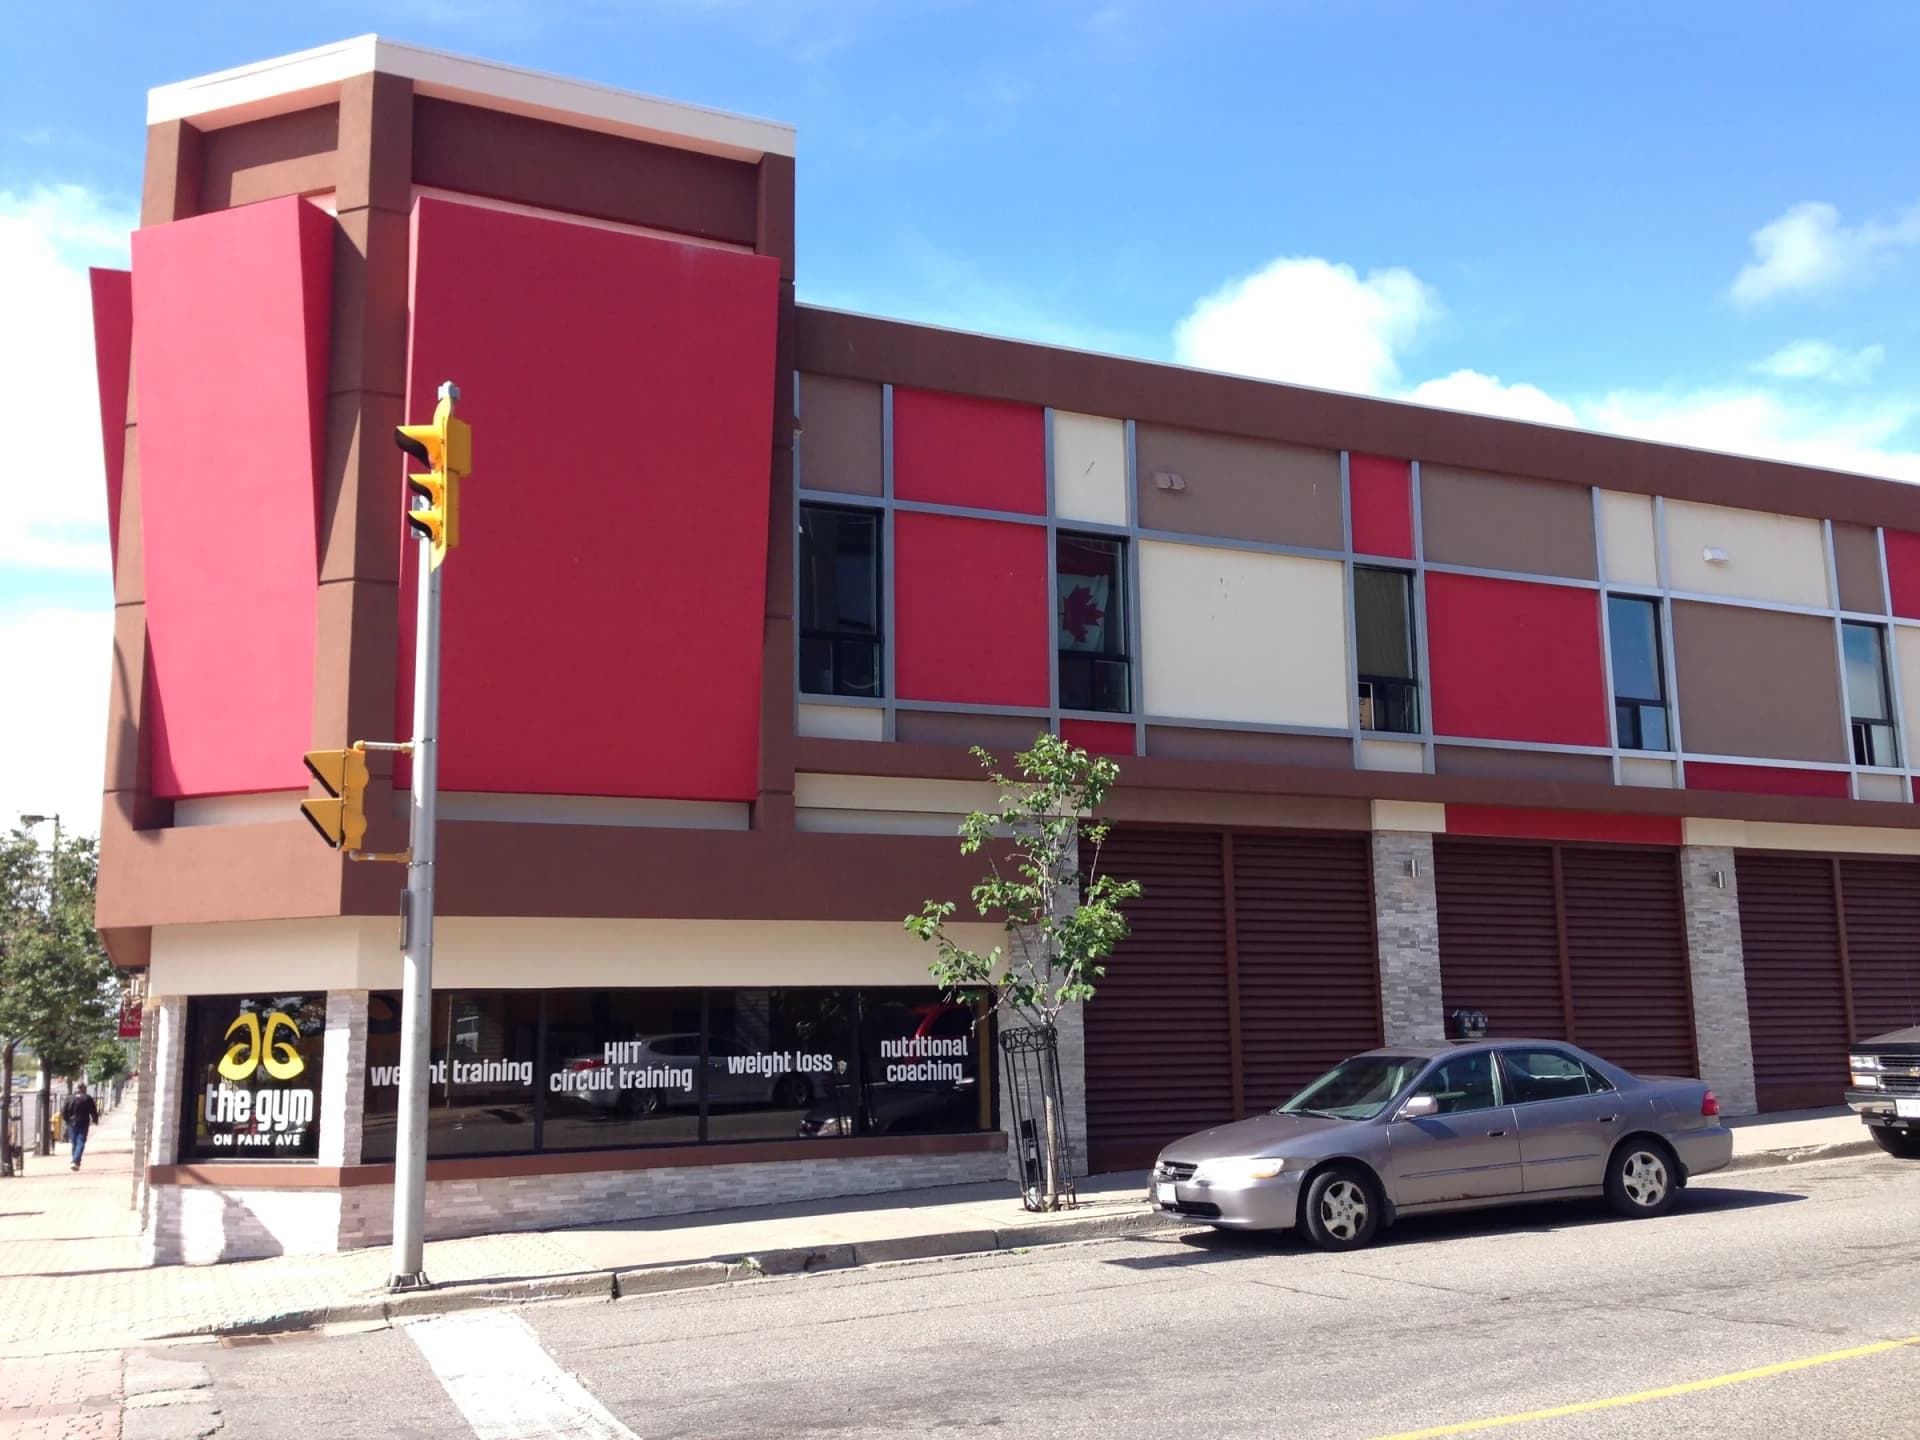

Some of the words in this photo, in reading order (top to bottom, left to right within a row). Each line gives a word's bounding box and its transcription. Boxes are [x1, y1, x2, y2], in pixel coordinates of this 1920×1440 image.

[604, 1041, 642, 1064] HIIT
[881, 1035, 968, 1057] nutritional
[371, 1060, 447, 1086] wet
[453, 1058, 533, 1086] training
[728, 1052, 791, 1077] weight
[796, 1051, 832, 1073] loss
[886, 1060, 963, 1085] coaching
[550, 1067, 614, 1092] circuit
[619, 1066, 693, 1092] training
[205, 1083, 251, 1122] the
[256, 1089, 313, 1131] gym
[213, 1134, 232, 1146] ON
[238, 1134, 270, 1146] PARK
[275, 1134, 301, 1146] AVE
